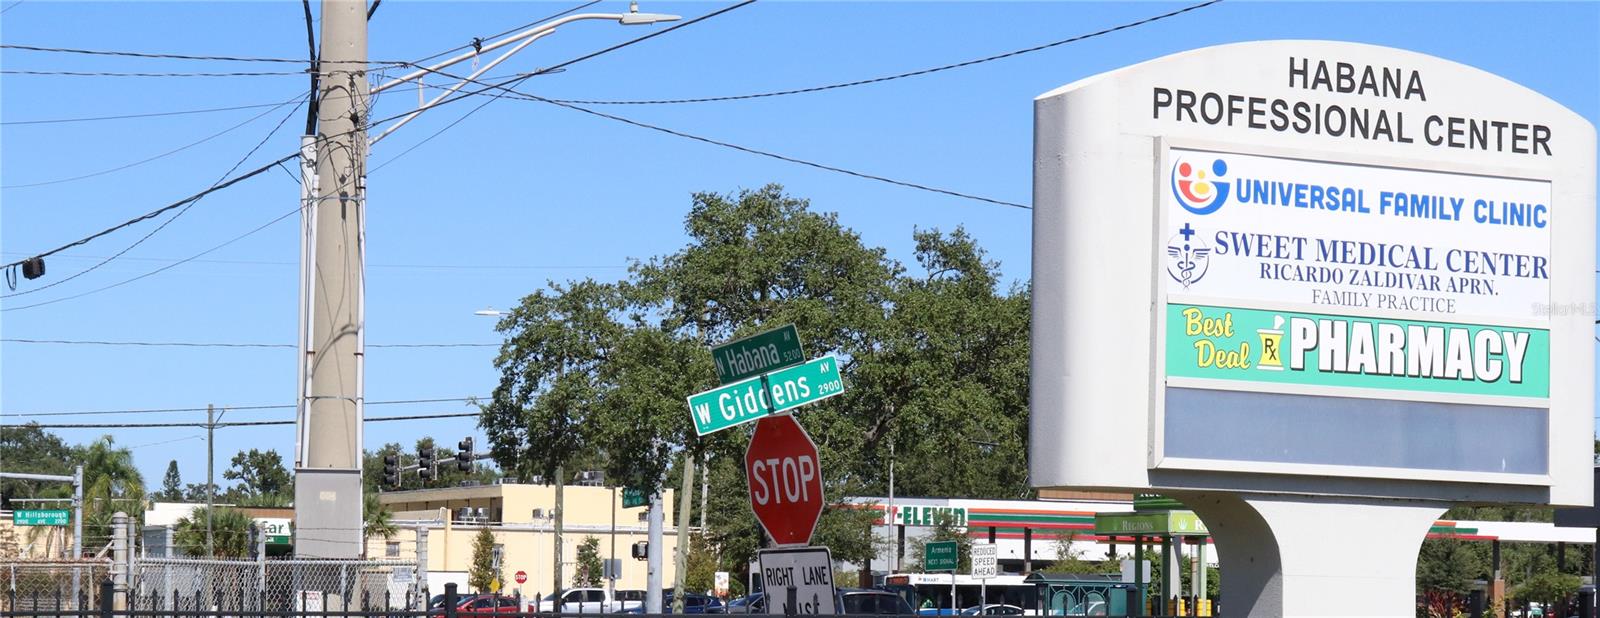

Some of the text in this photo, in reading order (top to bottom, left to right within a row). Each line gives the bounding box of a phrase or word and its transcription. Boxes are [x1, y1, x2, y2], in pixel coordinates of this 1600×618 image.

[1289, 56, 1426, 102] HABANA
[1153, 87, 1553, 156] PROFESSIONAL CENTER
[1236, 178, 1548, 229] UNIVERSAL FAMILY CLINIC
[1214, 230, 1549, 280] SWEET MEDICAL CENTER
[1259, 262, 1500, 296] RICARDO ZALDIVAR APRN.
[1311, 289, 1456, 314] FAMILY PRACTICE
[1182, 307, 1235, 338] Best
[715, 343, 801, 377] N Habana 5200
[1193, 338, 1252, 370] Deal
[1289, 317, 1530, 384] PHARMACY
[820, 361, 830, 374] AV
[695, 376, 841, 425] W Giddens 2900
[752, 455, 815, 506] STOP
[1122, 520, 1153, 531] REGIONS
[974, 547, 995, 556] REDUCED
[974, 557, 995, 566] SPEED
[765, 566, 828, 586] RIGHT LANE
[974, 567, 995, 576] AHEAD
